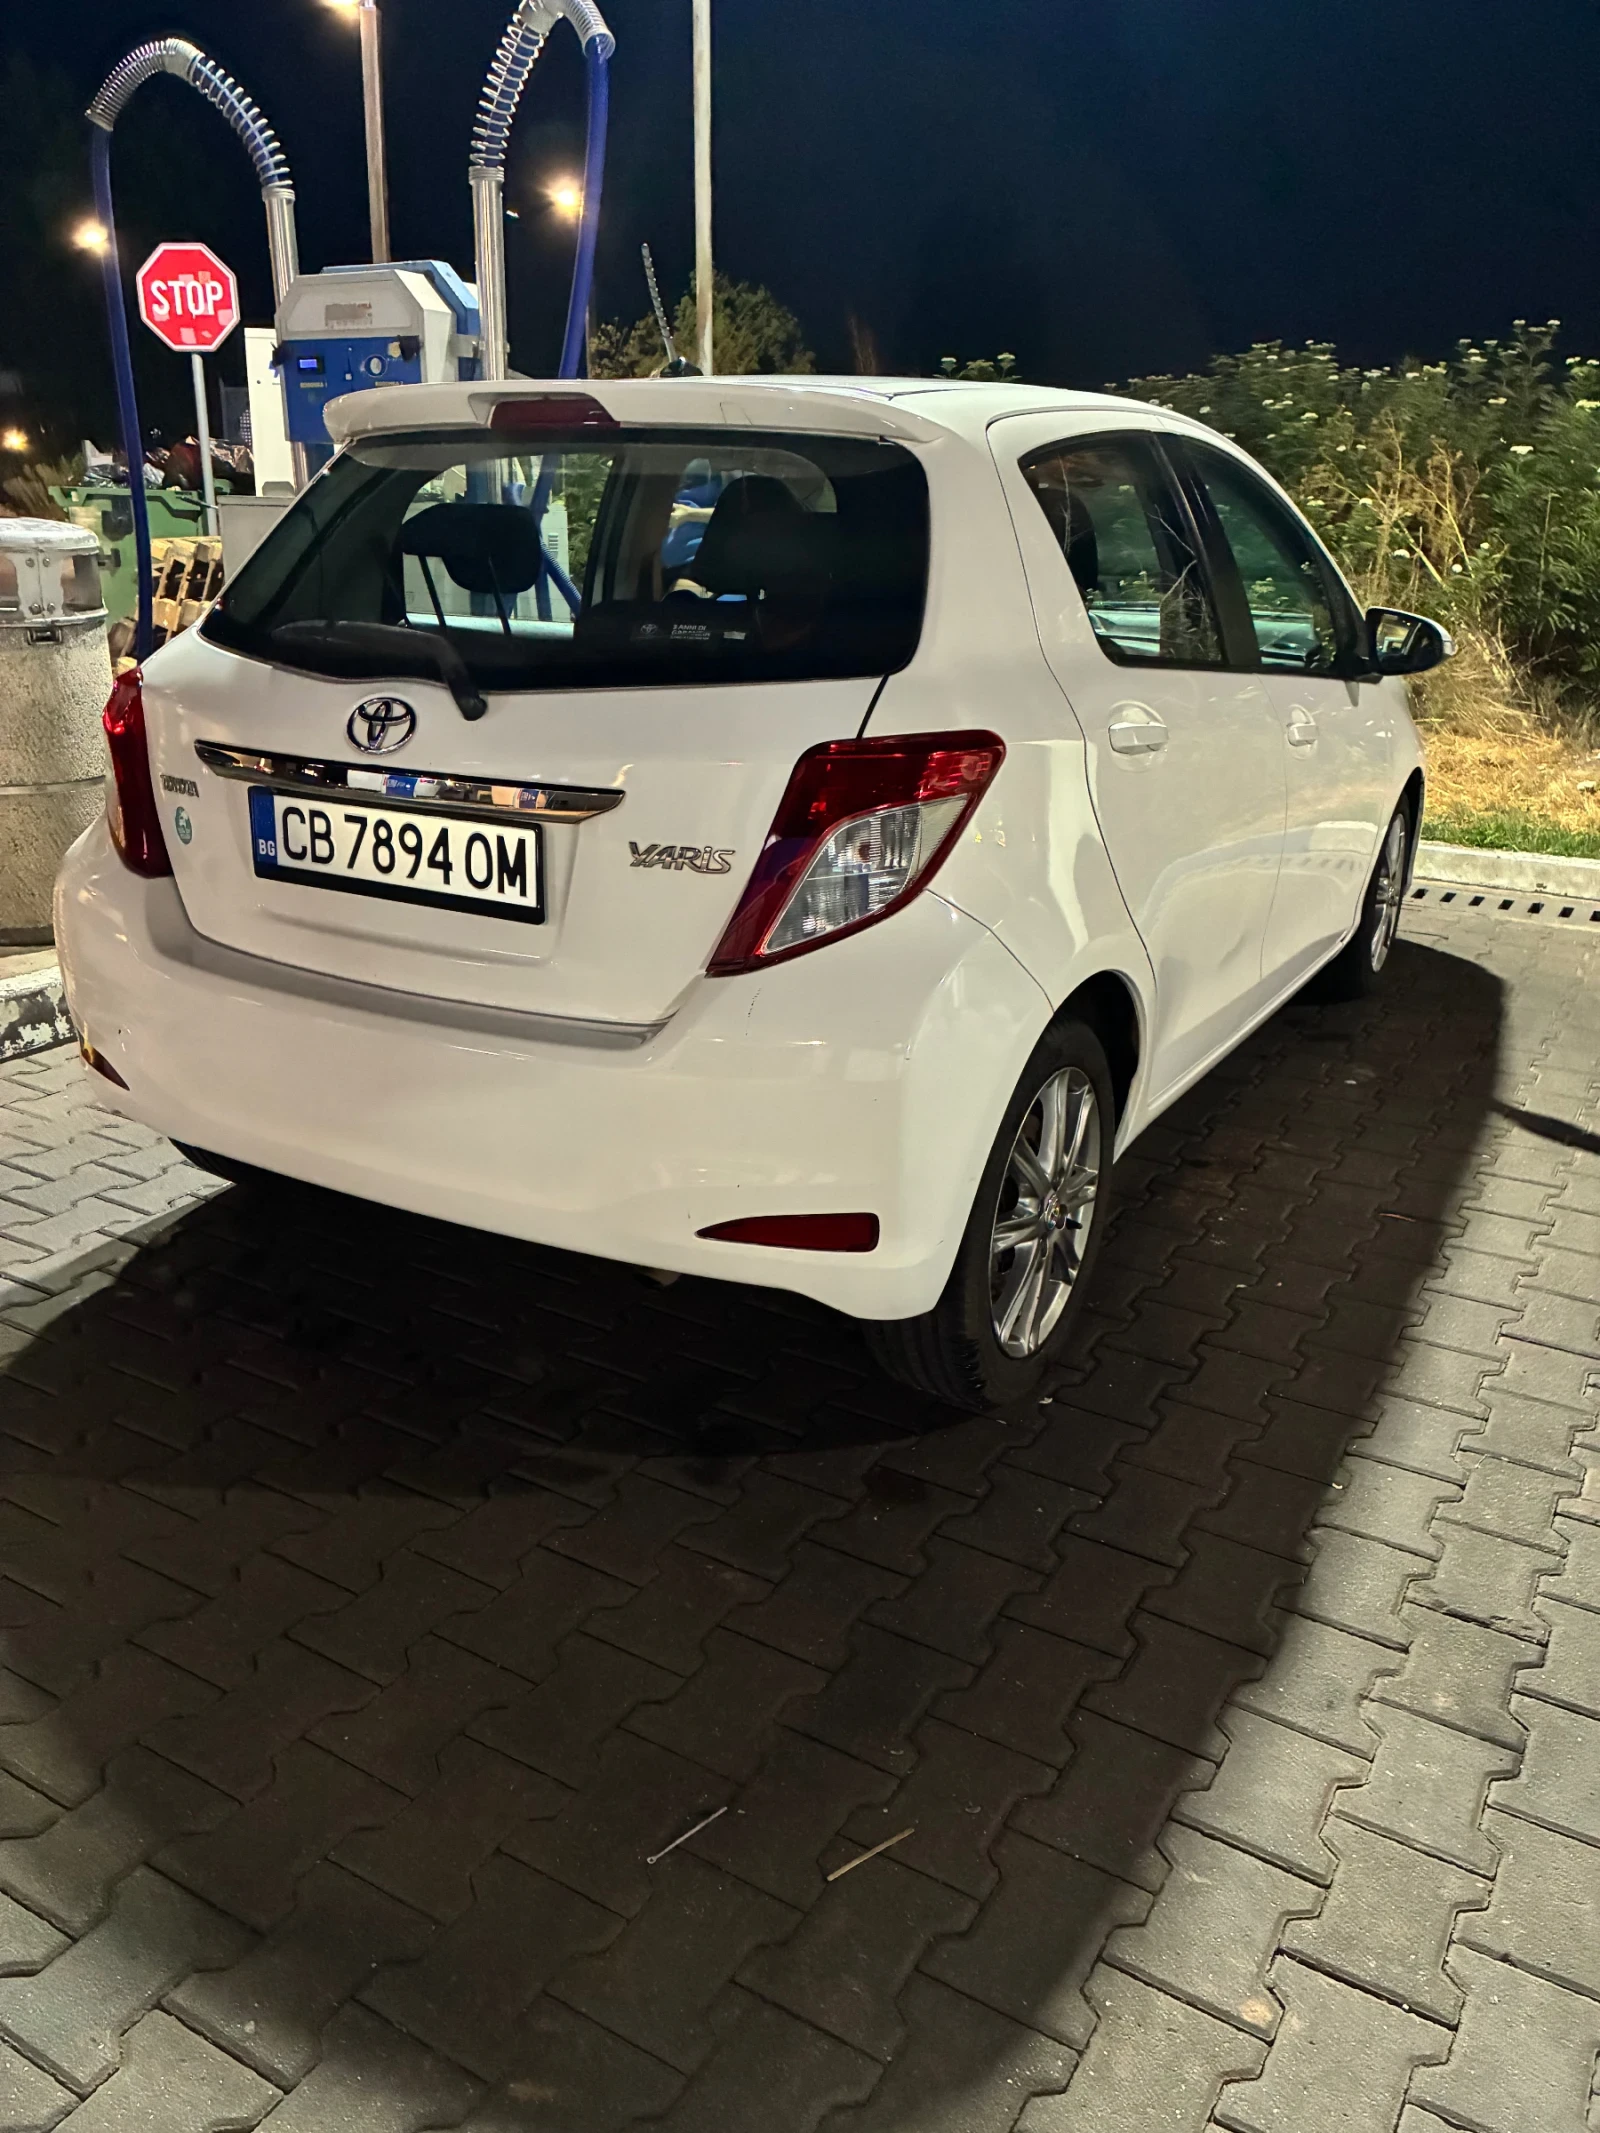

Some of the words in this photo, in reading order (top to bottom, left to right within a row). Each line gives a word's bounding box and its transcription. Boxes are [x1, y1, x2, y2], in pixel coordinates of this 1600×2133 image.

[150, 279, 223, 315] STOP
[258, 839, 276, 857] BG
[282, 807, 335, 865] CB
[344, 814, 453, 885] 7894
[465, 832, 527, 897] OM
